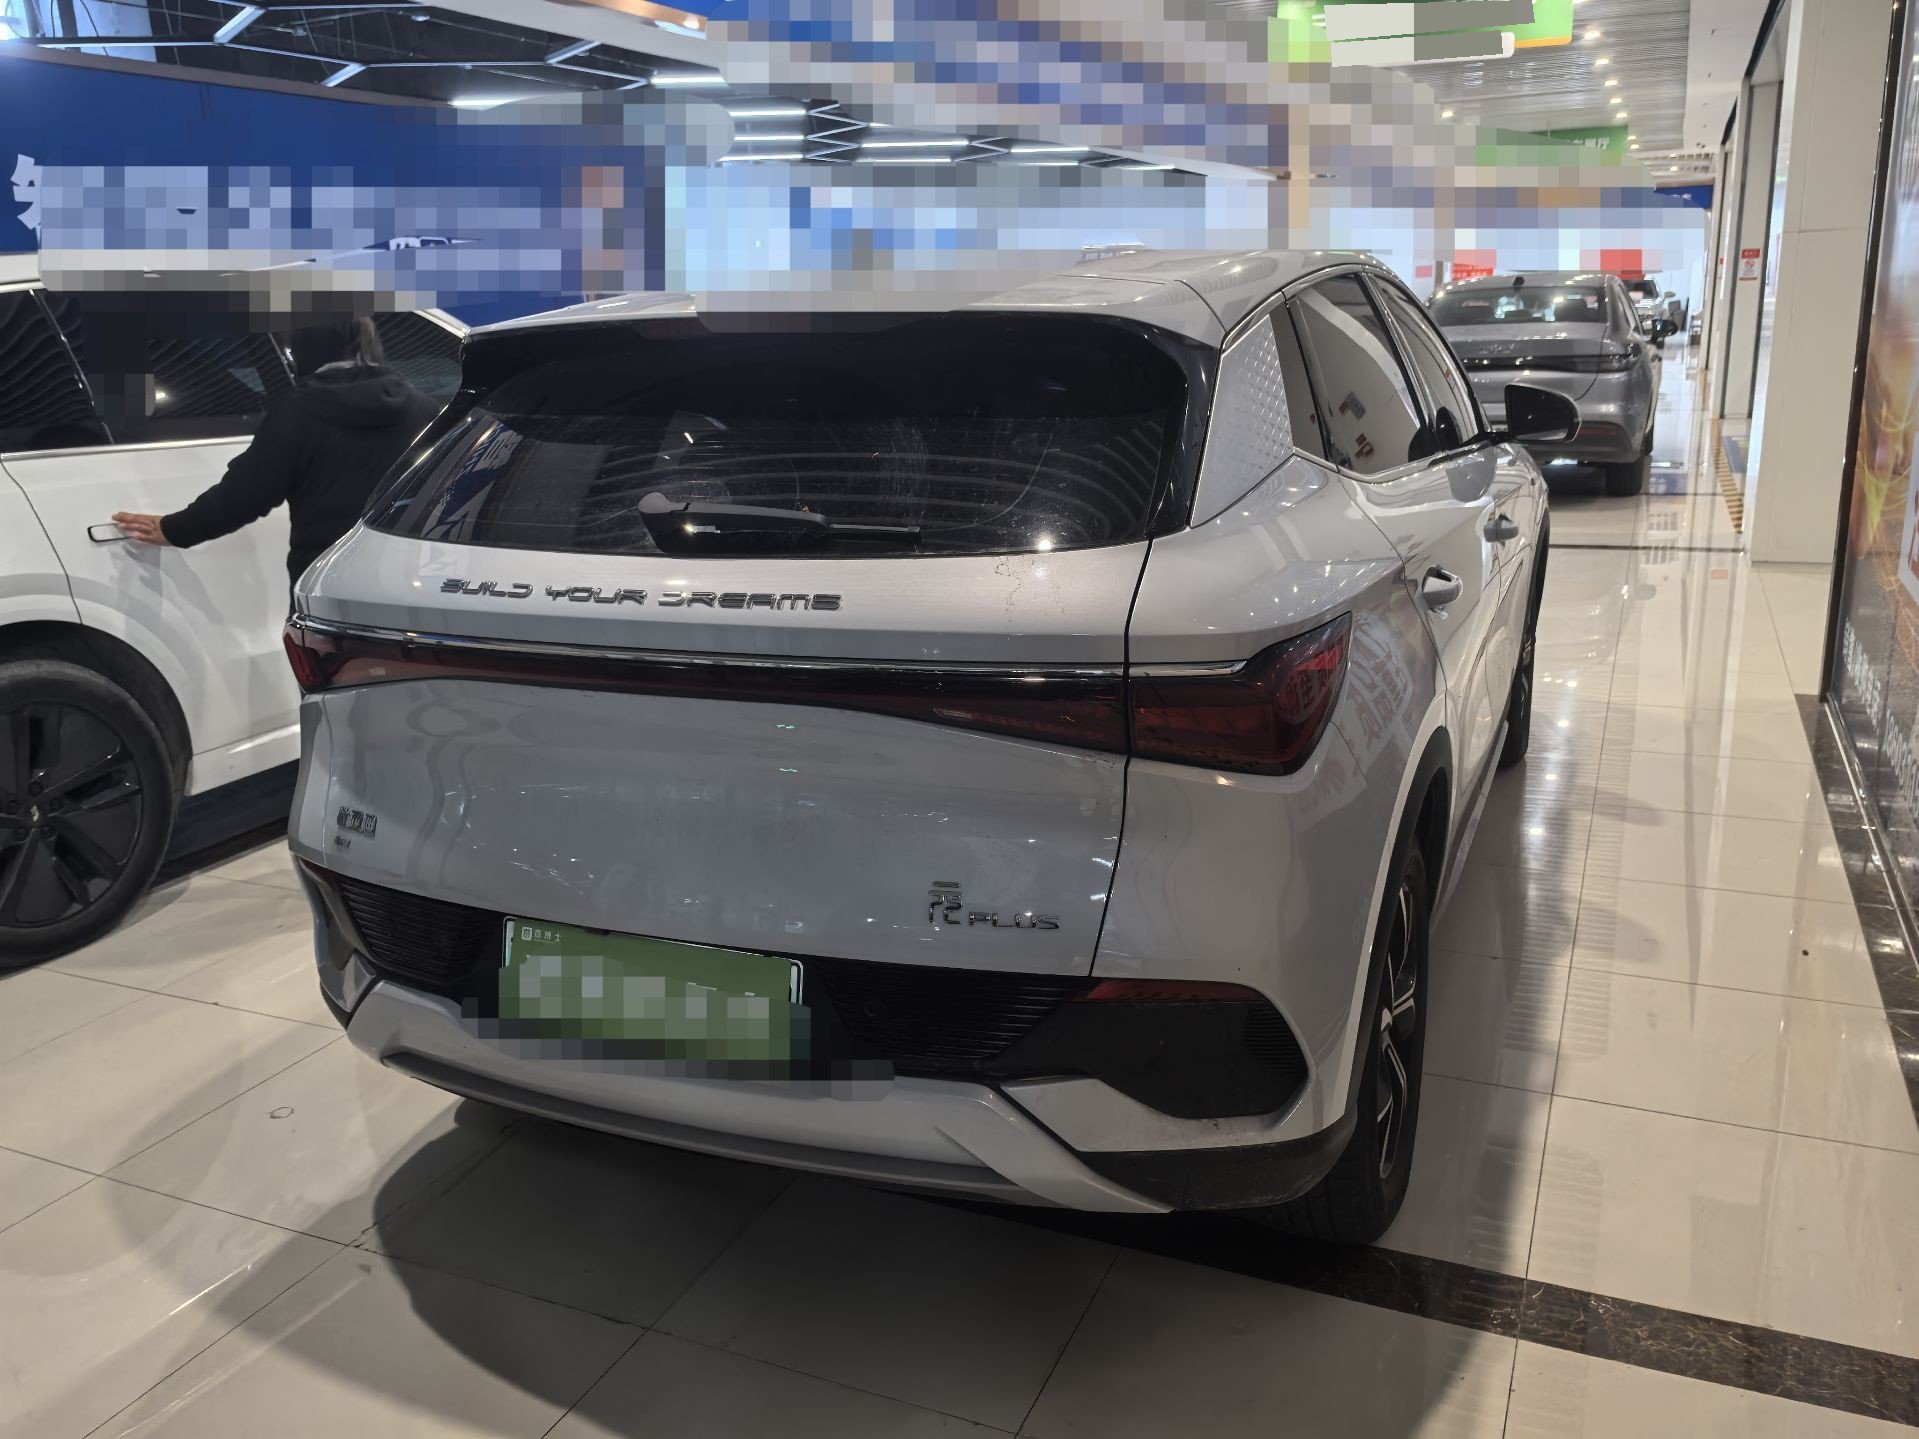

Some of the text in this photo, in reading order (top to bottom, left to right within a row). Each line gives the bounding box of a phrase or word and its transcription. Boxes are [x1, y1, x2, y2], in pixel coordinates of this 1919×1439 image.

[440, 578, 843, 611] BUILD YOUR DREAMS
[968, 911, 1061, 930] PLUS
